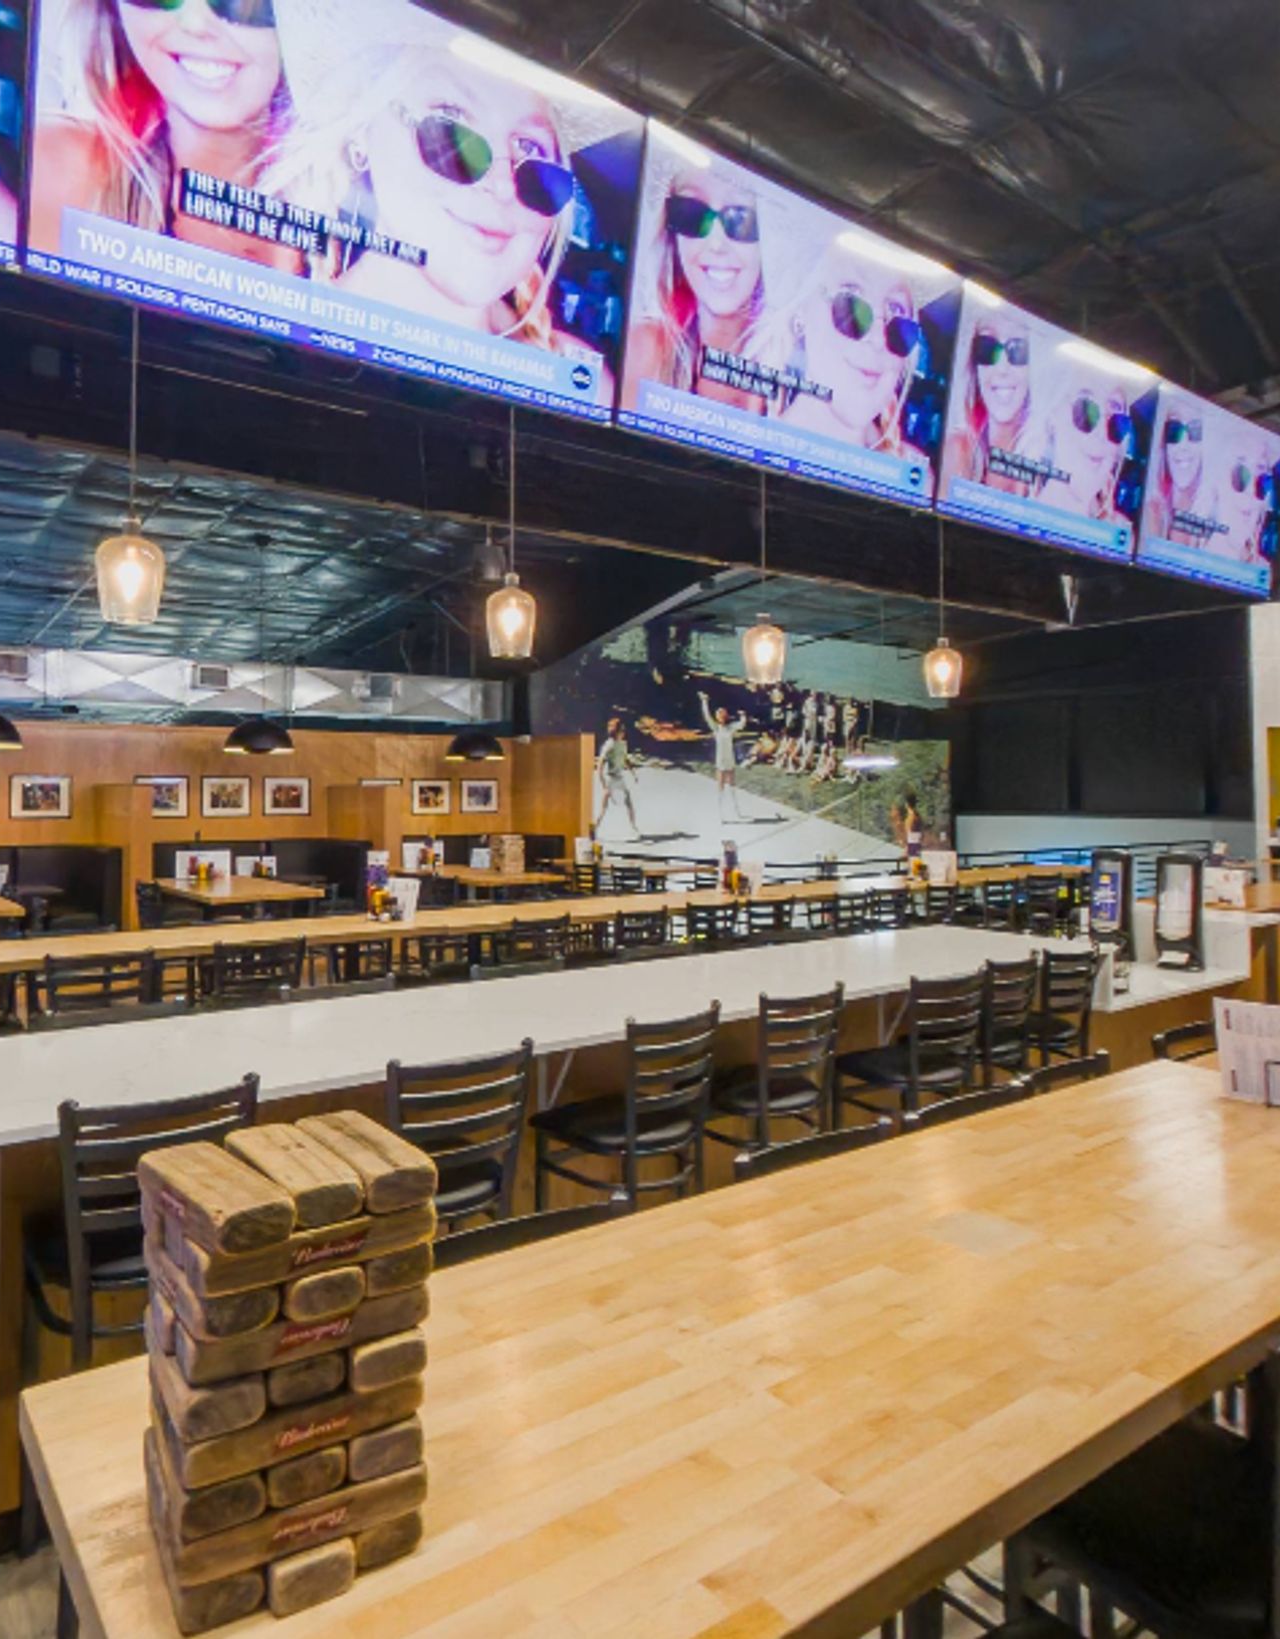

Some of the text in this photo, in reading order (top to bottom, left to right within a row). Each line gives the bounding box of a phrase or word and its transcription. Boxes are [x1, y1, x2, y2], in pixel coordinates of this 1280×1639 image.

[187, 169, 227, 199] THEY
[229, 181, 263, 210] TELL
[237, 208, 256, 233] TO
[258, 216, 278, 241] BE
[64, 266, 102, 290] WAR
[182, 297, 256, 328] PENTAGON
[76, 227, 127, 261] TWO
[130, 242, 232, 291] AMERICAN
[236, 273, 308, 313] WOMEN
[311, 296, 367, 328] BITTEN
[370, 313, 390, 333] BY
[392, 319, 442, 351] SHARK
